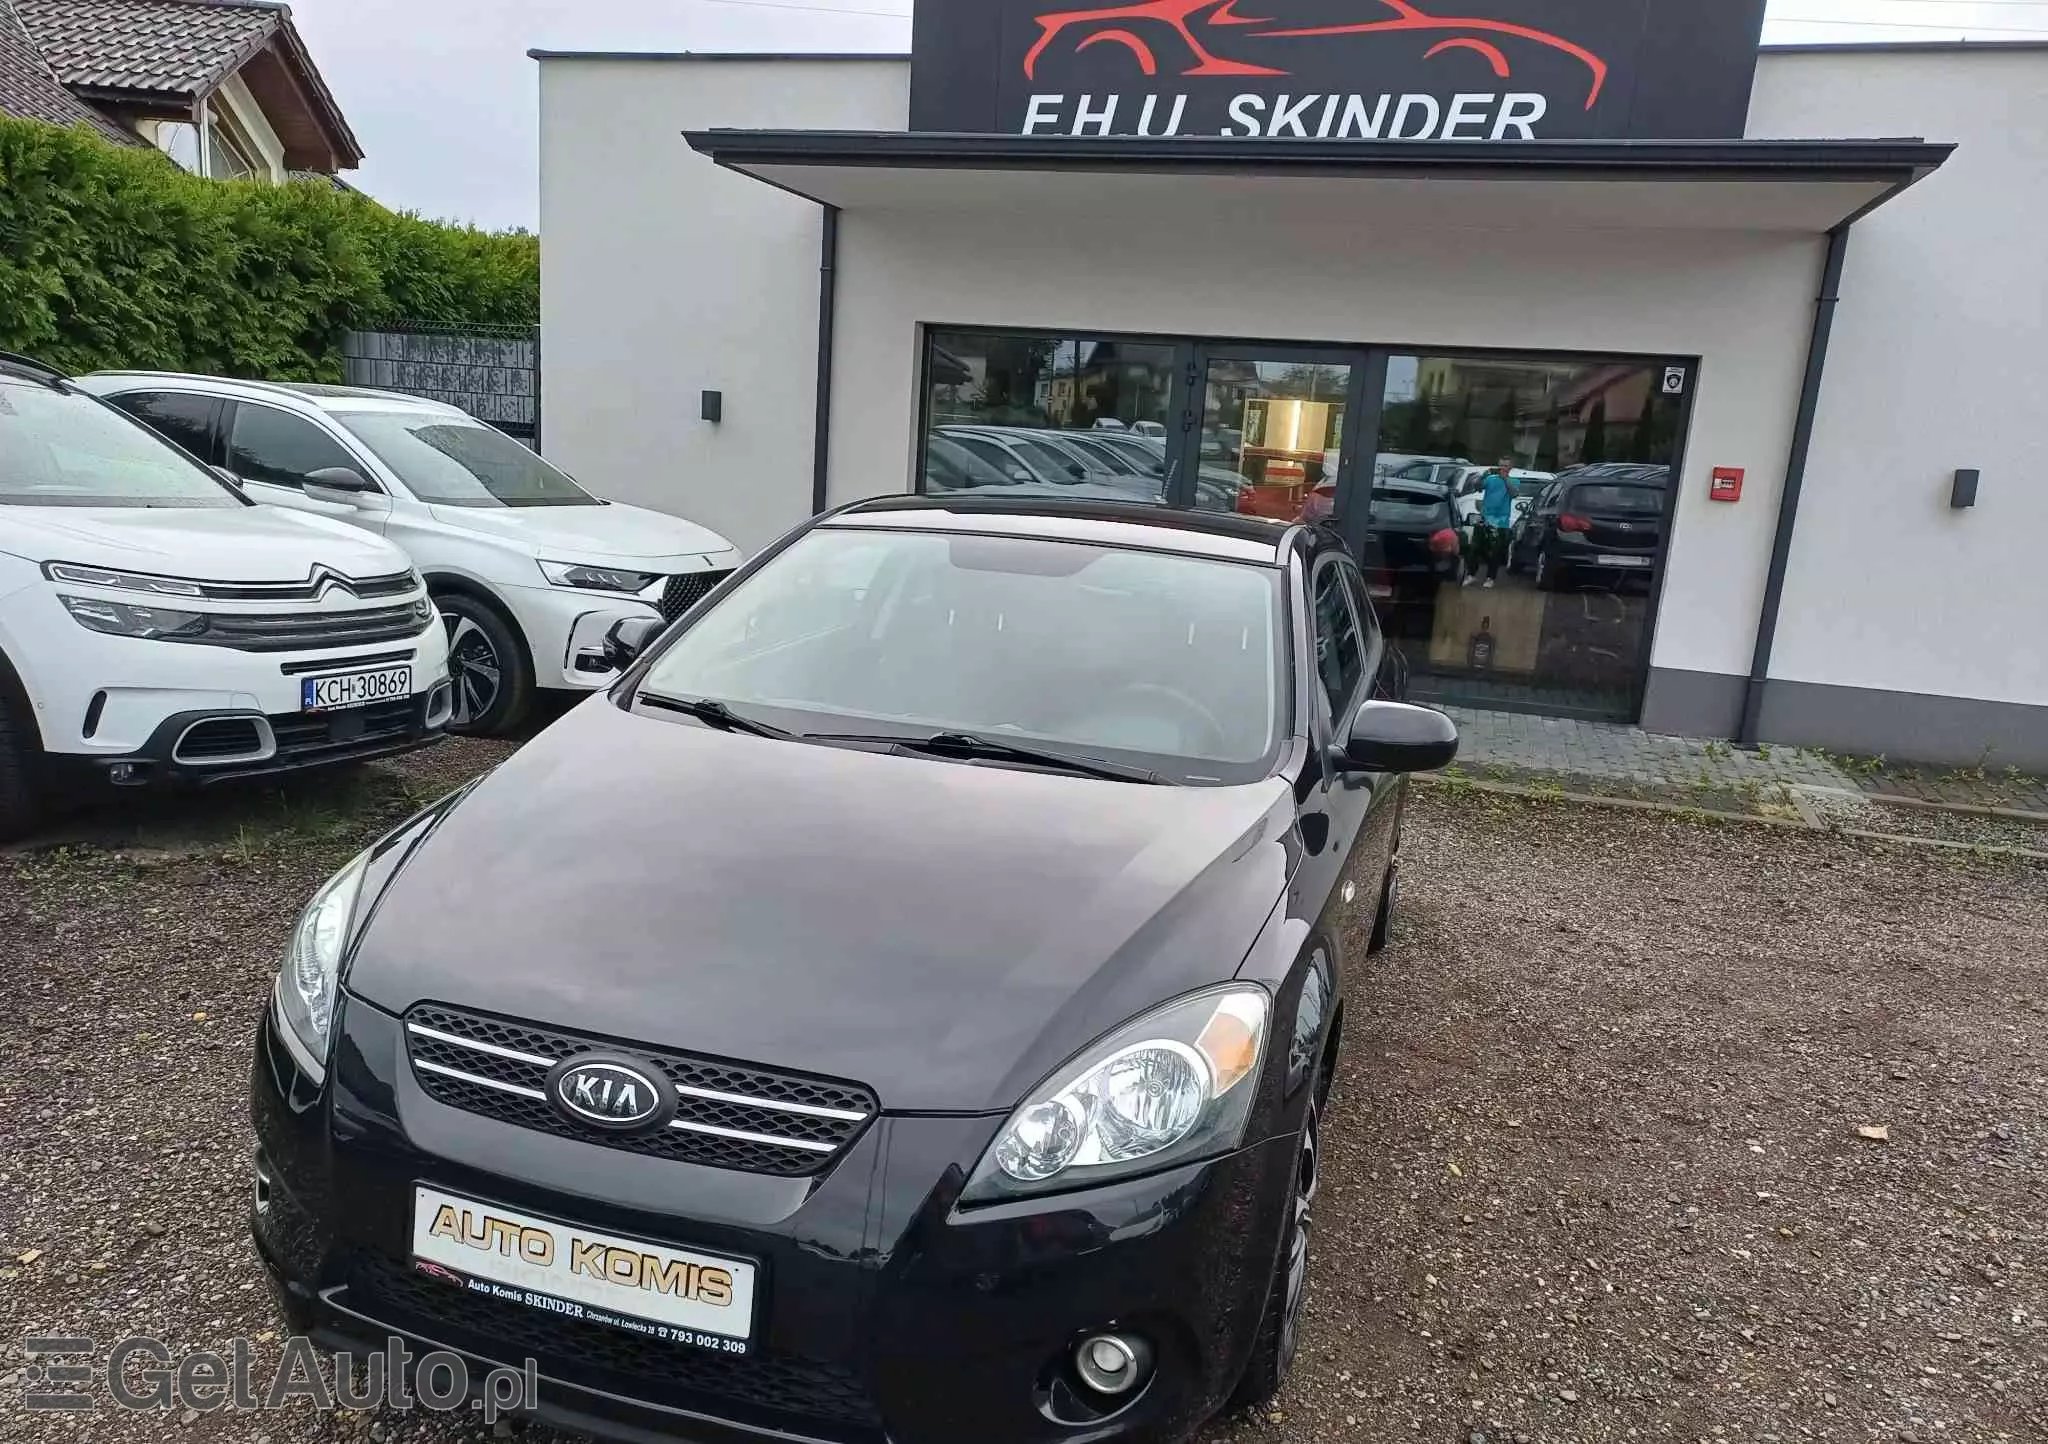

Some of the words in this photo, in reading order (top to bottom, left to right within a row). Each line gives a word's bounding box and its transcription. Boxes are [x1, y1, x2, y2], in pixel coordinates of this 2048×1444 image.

[1021, 94, 1193, 136] FHU
[1219, 92, 1547, 140] SKINDER
[315, 679, 352, 705] KCH
[357, 670, 408, 699] 30869
[575, 1074, 637, 1114] KIA
[429, 1204, 554, 1267] AUTO
[571, 1239, 733, 1307] KOMIS
[468, 1279, 490, 1293] Auto
[492, 1285, 523, 1302] Komis
[525, 1292, 584, 1318] SKINDER
[670, 1328, 693, 1343] 793
[696, 1335, 719, 1349] 002
[722, 1340, 746, 1354] 309
